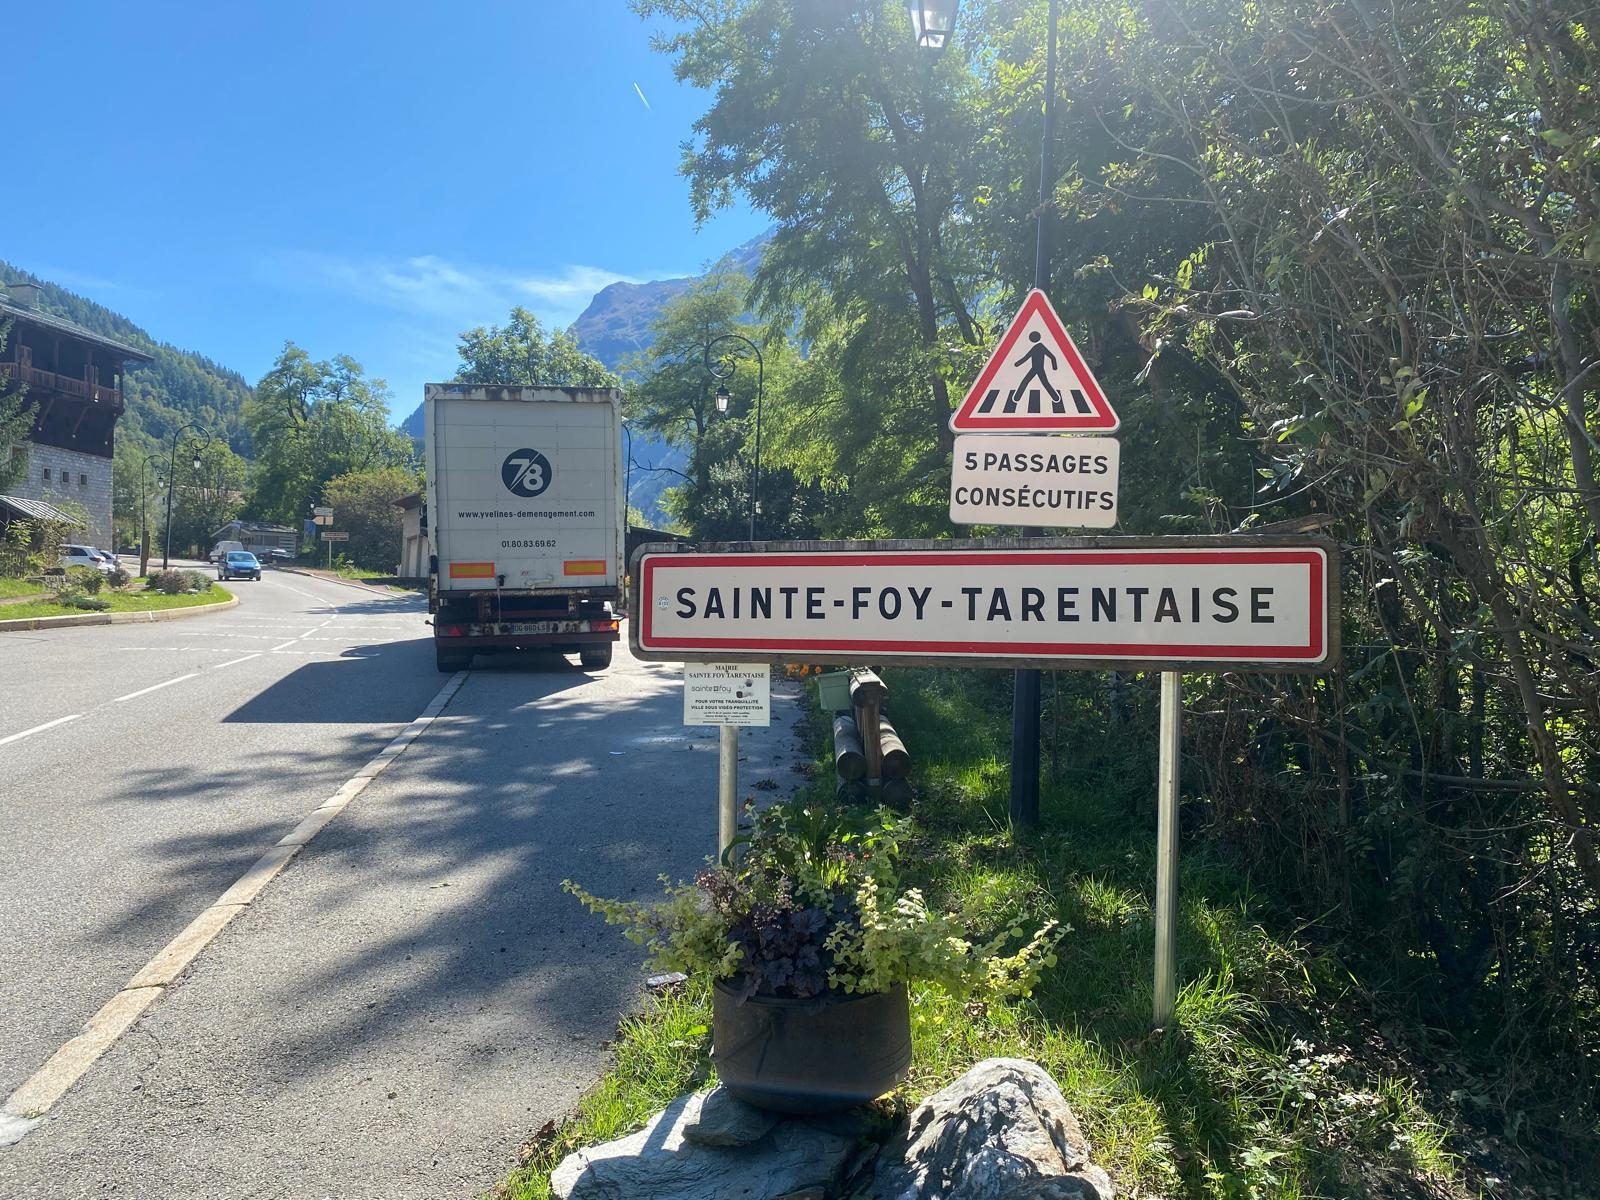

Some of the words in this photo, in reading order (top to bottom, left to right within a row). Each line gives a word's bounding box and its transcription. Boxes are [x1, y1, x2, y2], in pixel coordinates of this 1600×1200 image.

[965, 452, 978, 471] 5
[983, 453, 1108, 475] PASSAGES
[955, 485, 1114, 511] CONSÉCUTIFS
[458, 510, 595, 519] www.yvelines-demenagement.com
[501, 540, 557, 548] 01.80.83.69.62
[676, 587, 1275, 624] SAINTE-FOY-TARENTAISE
